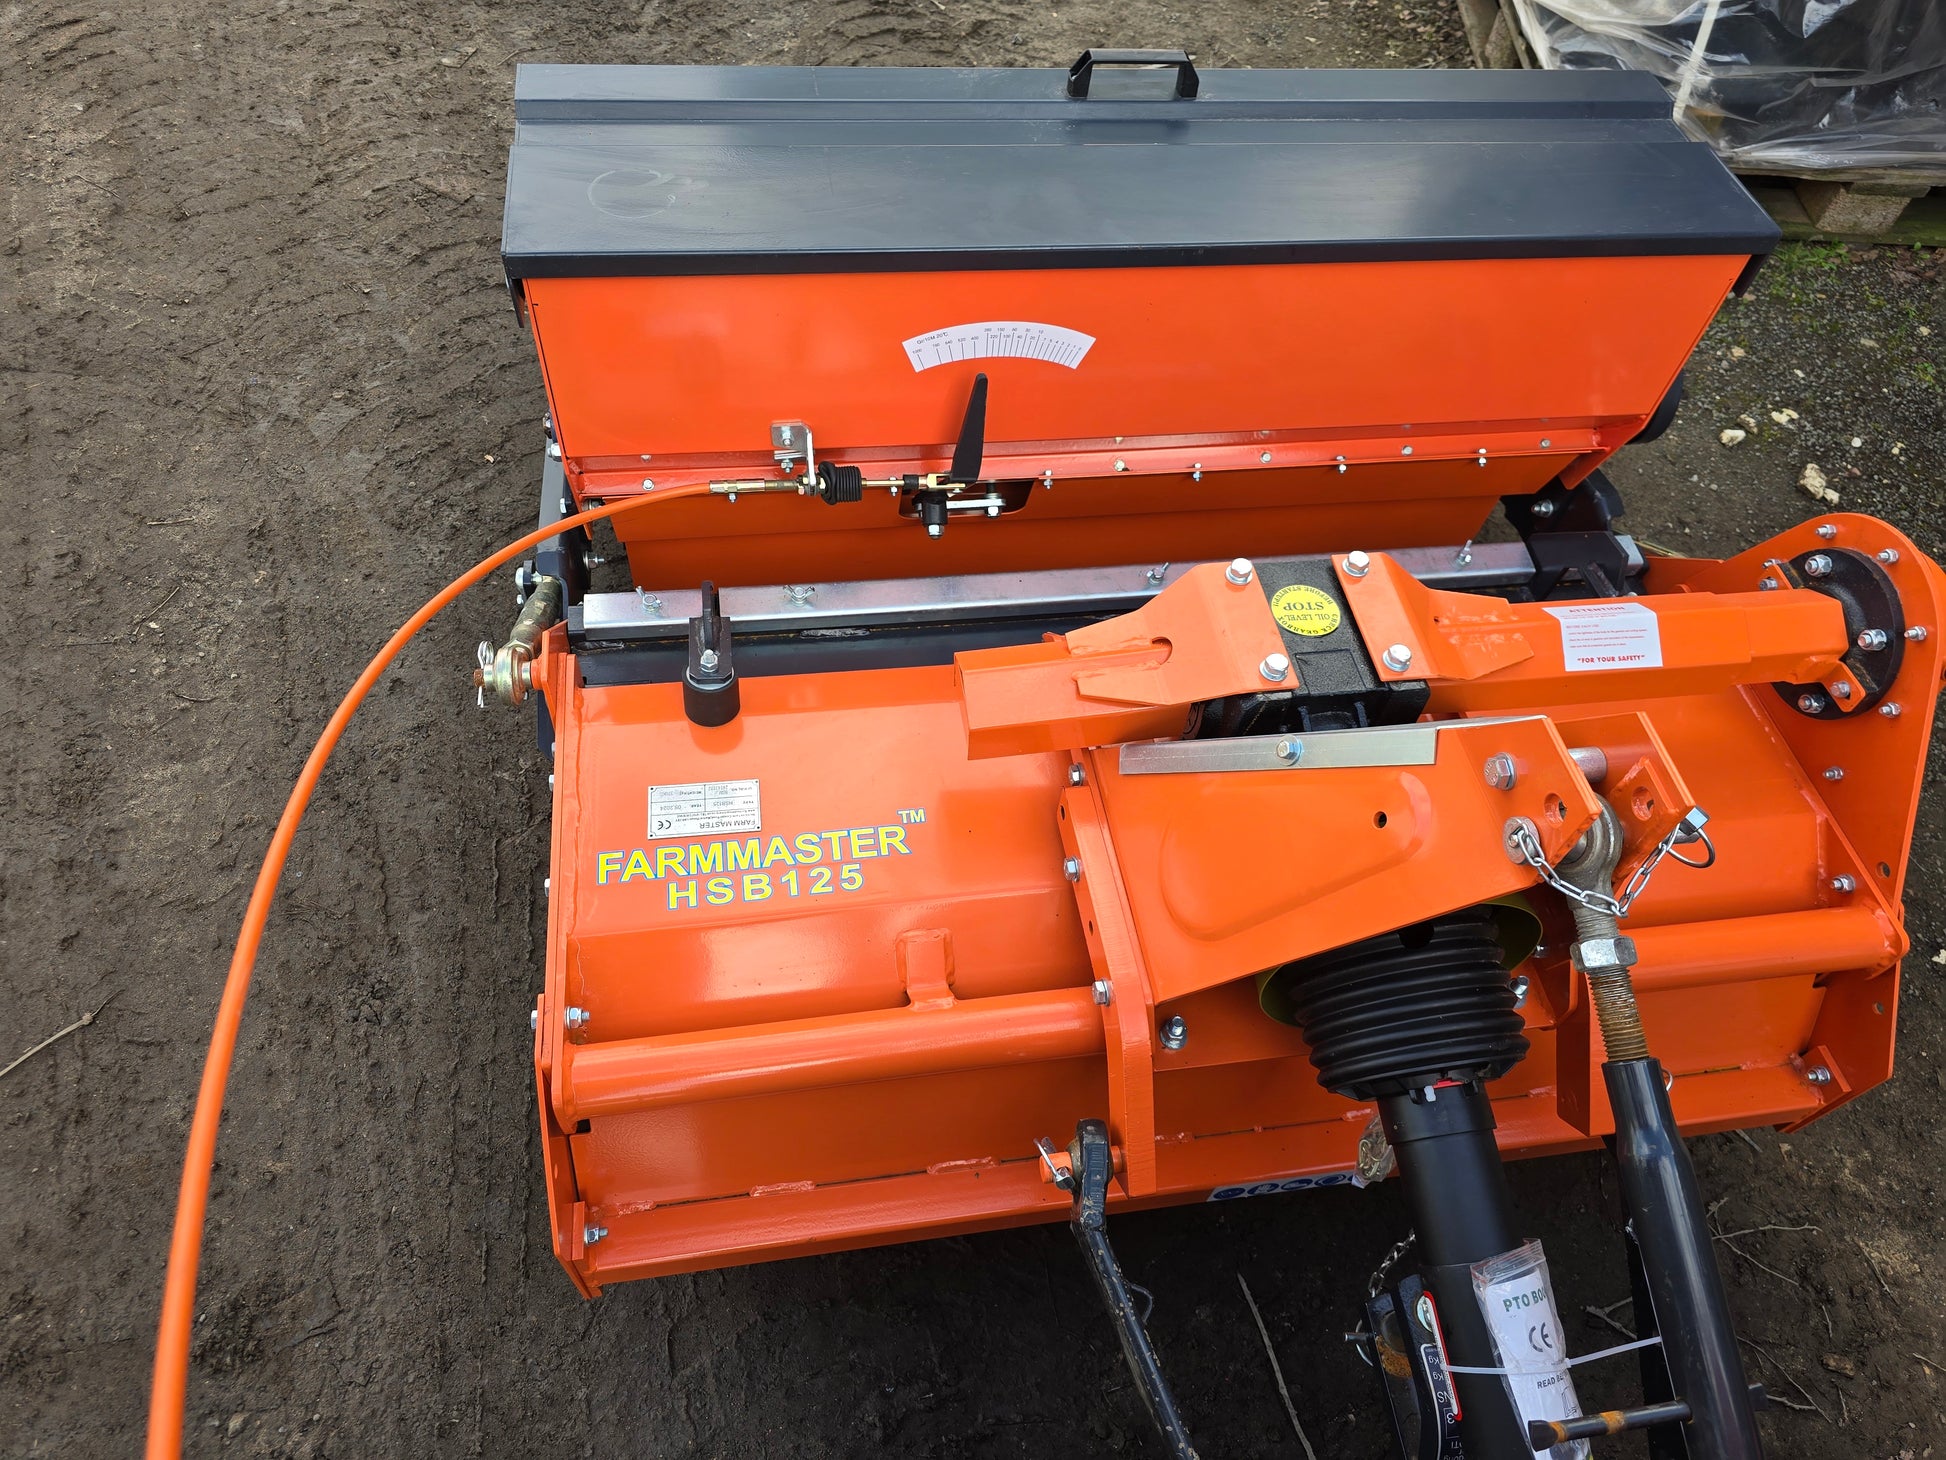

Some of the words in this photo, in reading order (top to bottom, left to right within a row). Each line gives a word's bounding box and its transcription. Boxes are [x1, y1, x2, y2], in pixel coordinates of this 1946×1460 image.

[1283, 602, 1324, 610] STOP
[700, 820, 732, 829] MASTER
[597, 825, 911, 886] FARMMASTER
[667, 863, 864, 911] HSB125
[1502, 1294, 1530, 1312] PTO
[1536, 1377, 1556, 1390] READ
